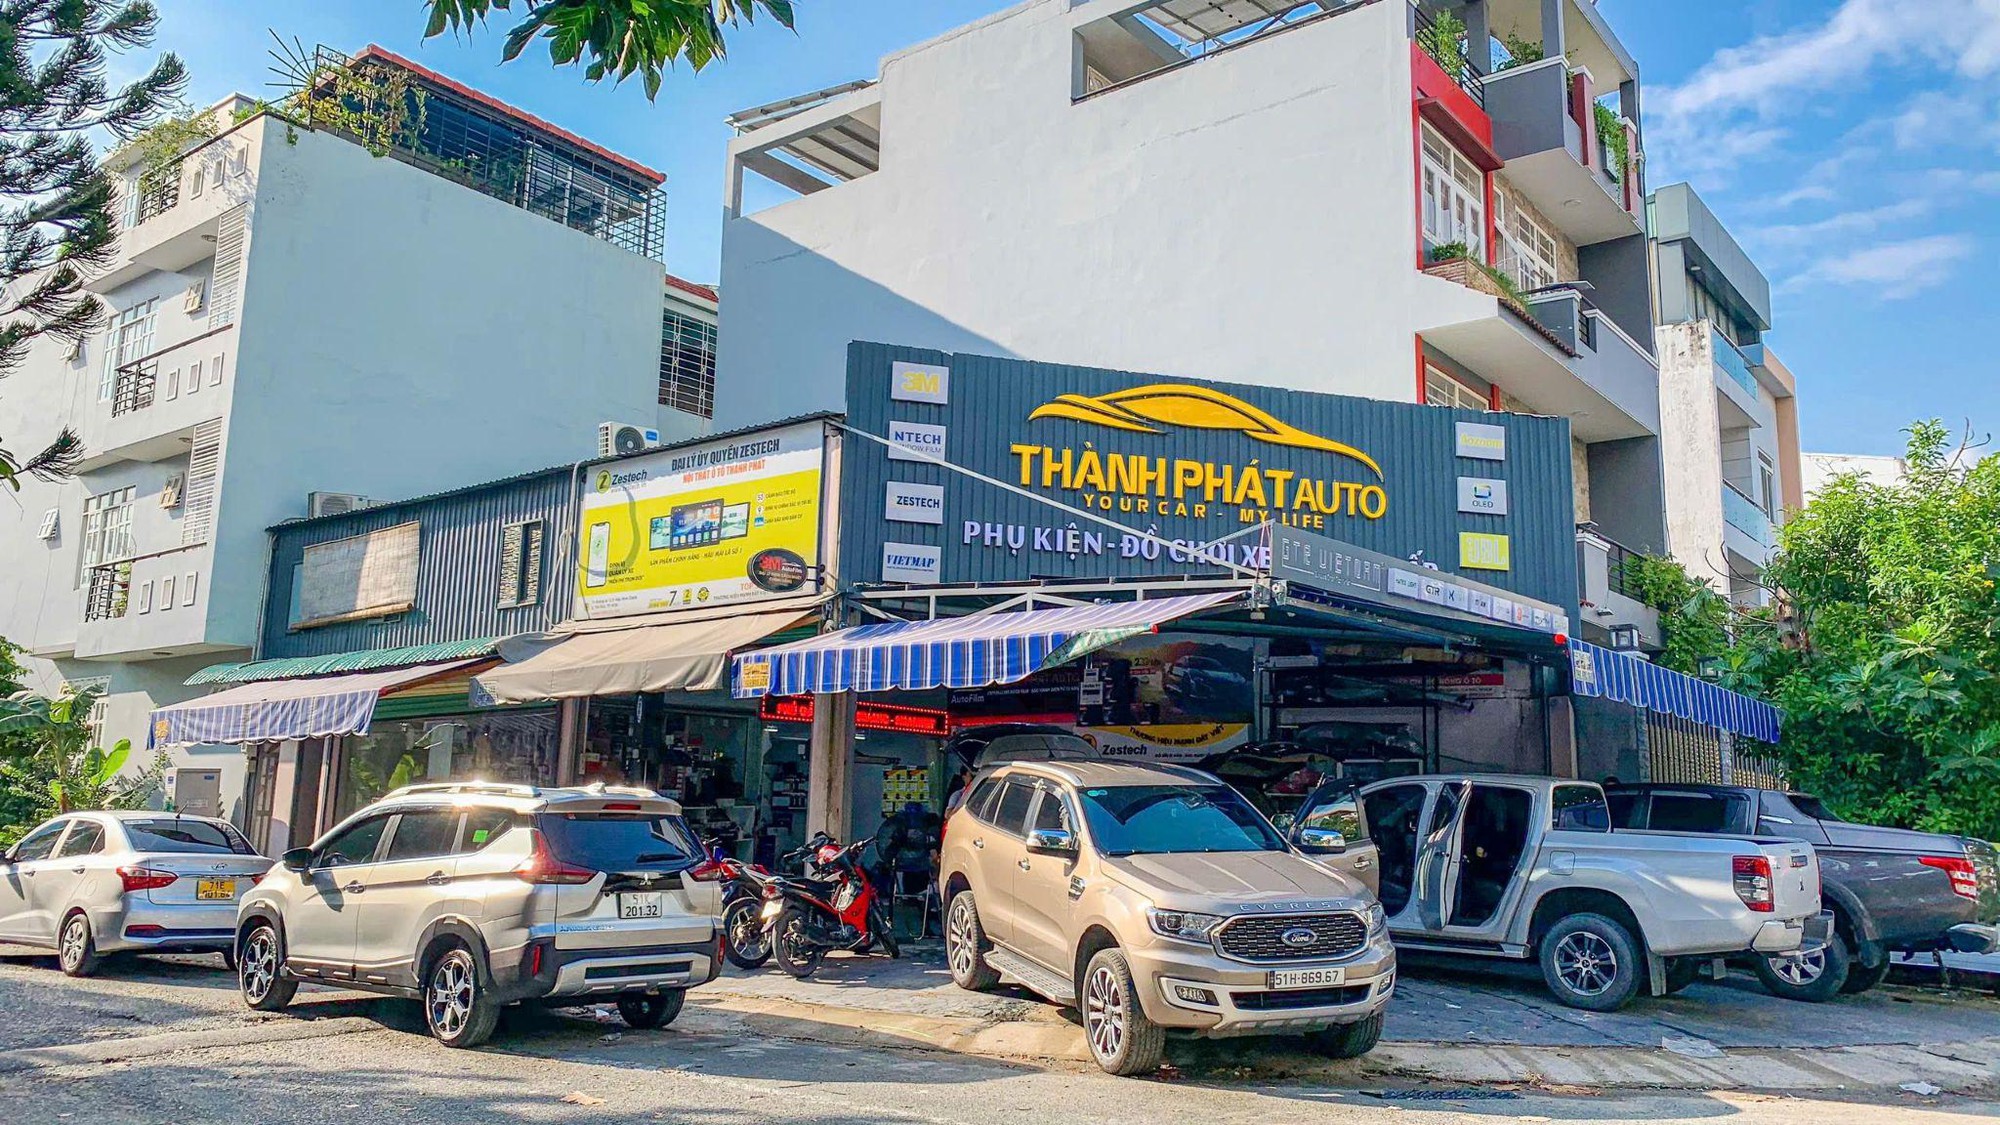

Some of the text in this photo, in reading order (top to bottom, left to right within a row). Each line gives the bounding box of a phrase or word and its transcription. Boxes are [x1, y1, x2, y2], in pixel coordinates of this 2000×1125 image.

[902, 371, 940, 394] 3M
[894, 430, 941, 445] NTECH
[740, 438, 780, 458] ZESTECH
[612, 469, 648, 486] Zestech
[1010, 441, 1388, 520] THÀNH PHÁT AUTO
[896, 495, 940, 509] ZESTECH
[1083, 493, 1149, 514] YOUR
[1158, 501, 1207, 518] CAR
[1239, 508, 1269, 524] MY
[1282, 512, 1324, 529] LIFE
[963, 520, 1026, 556] PHỤ
[1033, 522, 1103, 560] KIỆN
[1119, 524, 1161, 561] ĐỒ
[1241, 544, 1271, 569] XE
[1466, 537, 1507, 565] JBL
[760, 554, 782, 571] 3M
[886, 554, 935, 569] VIETMAP
[951, 694, 985, 704] AutoFilm
[1102, 744, 1148, 755] Zestech
[625, 905, 658, 917] 201.32
[1239, 900, 1345, 912] EVEREST
[1291, 932, 1310, 943] Ford
